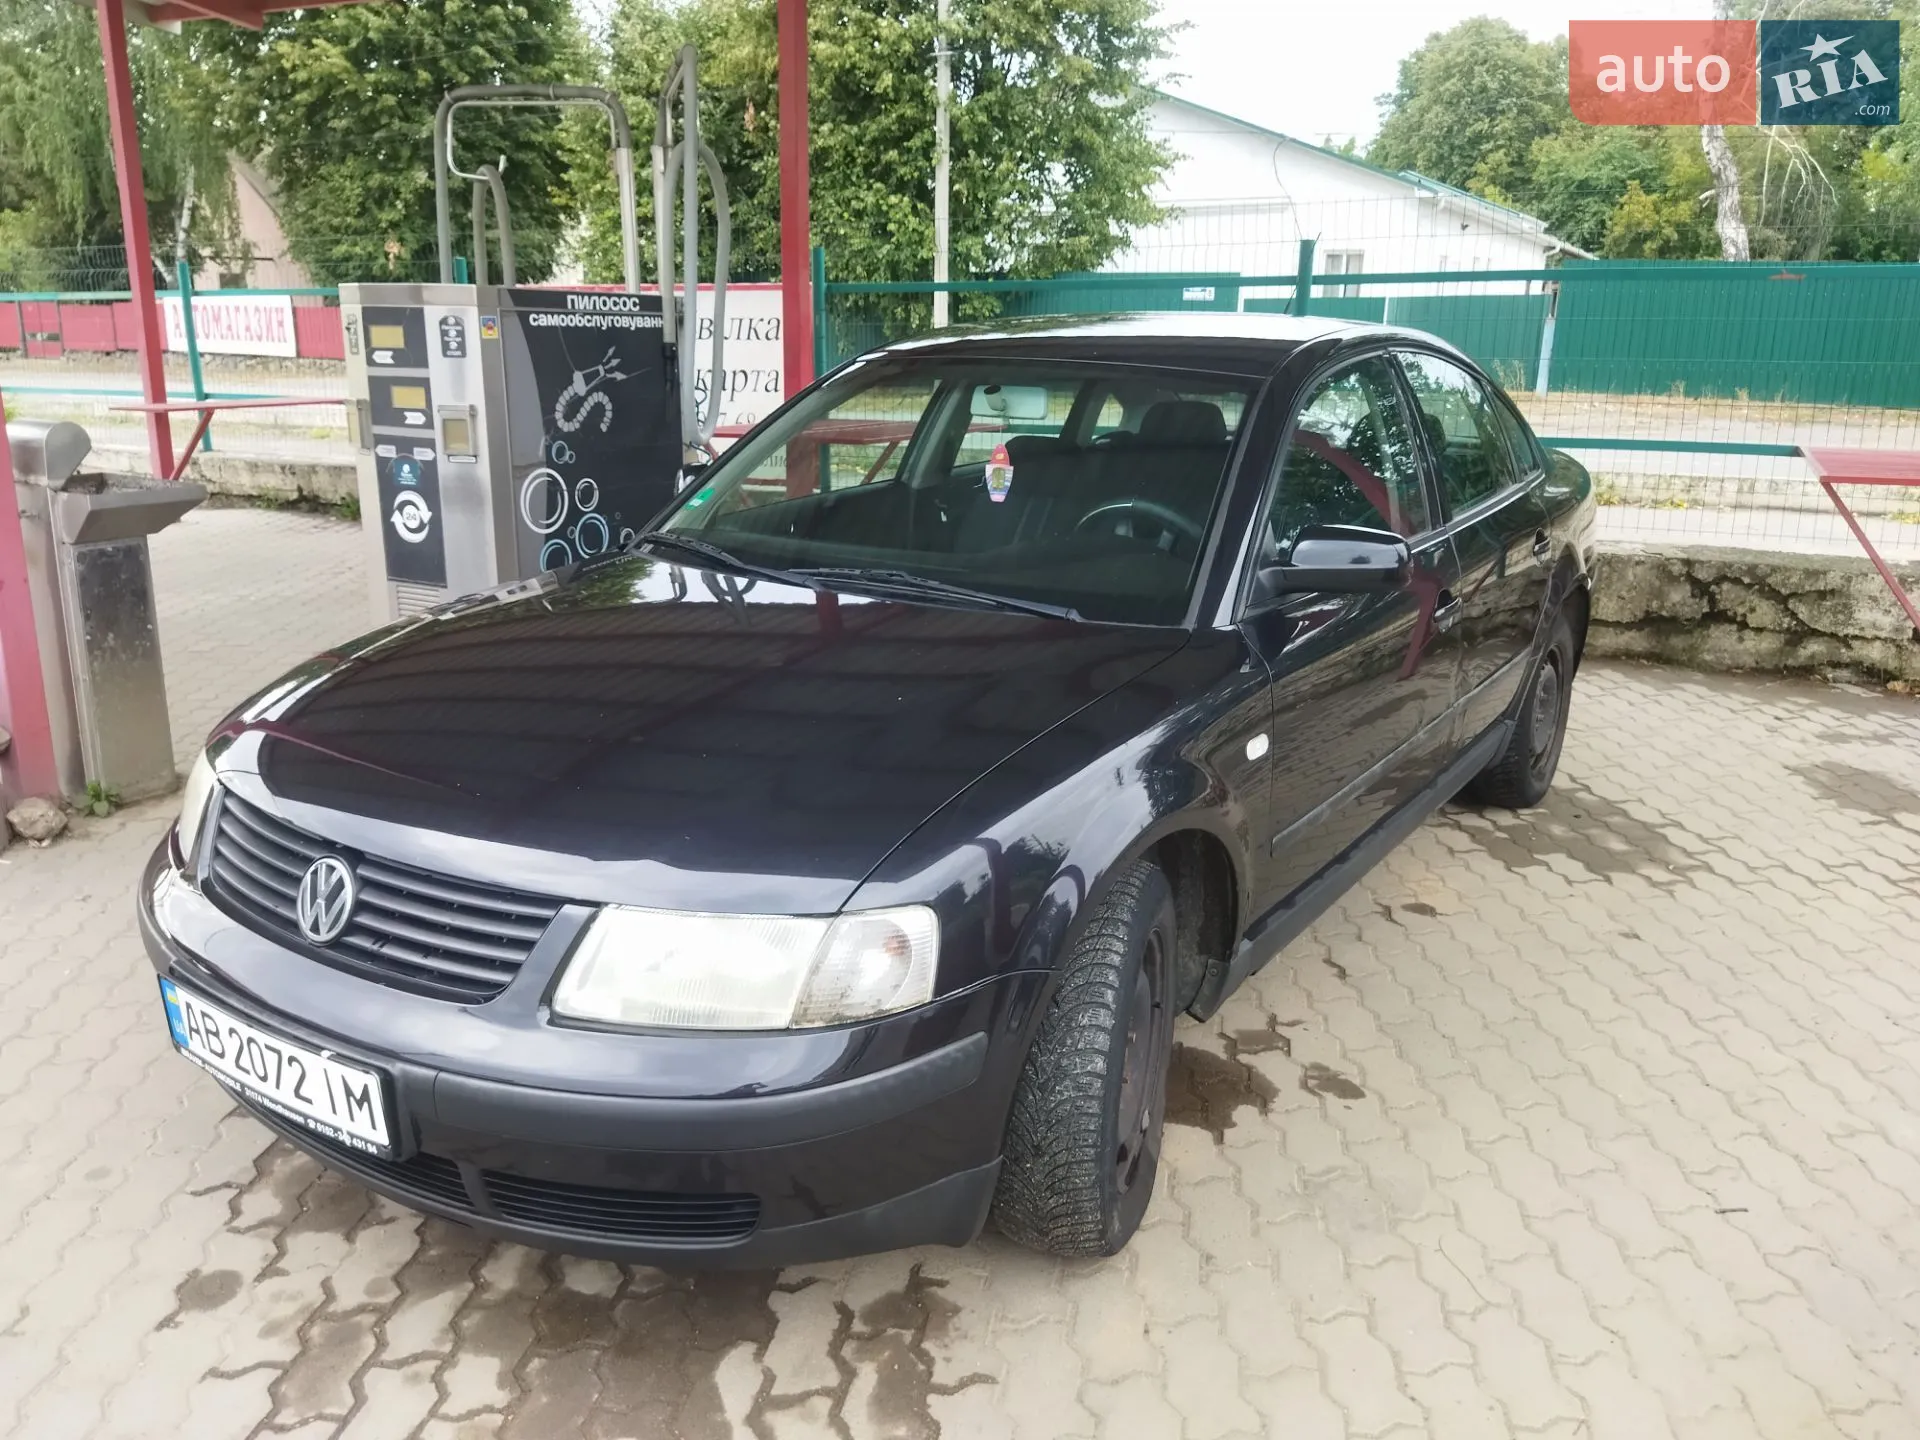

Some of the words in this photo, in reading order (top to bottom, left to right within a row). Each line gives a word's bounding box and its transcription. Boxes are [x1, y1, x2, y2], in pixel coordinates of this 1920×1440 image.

[566, 294, 640, 312] ПИЛОСОС
[172, 303, 288, 344] АТОМАГАЗИН
[697, 316, 780, 341] влка
